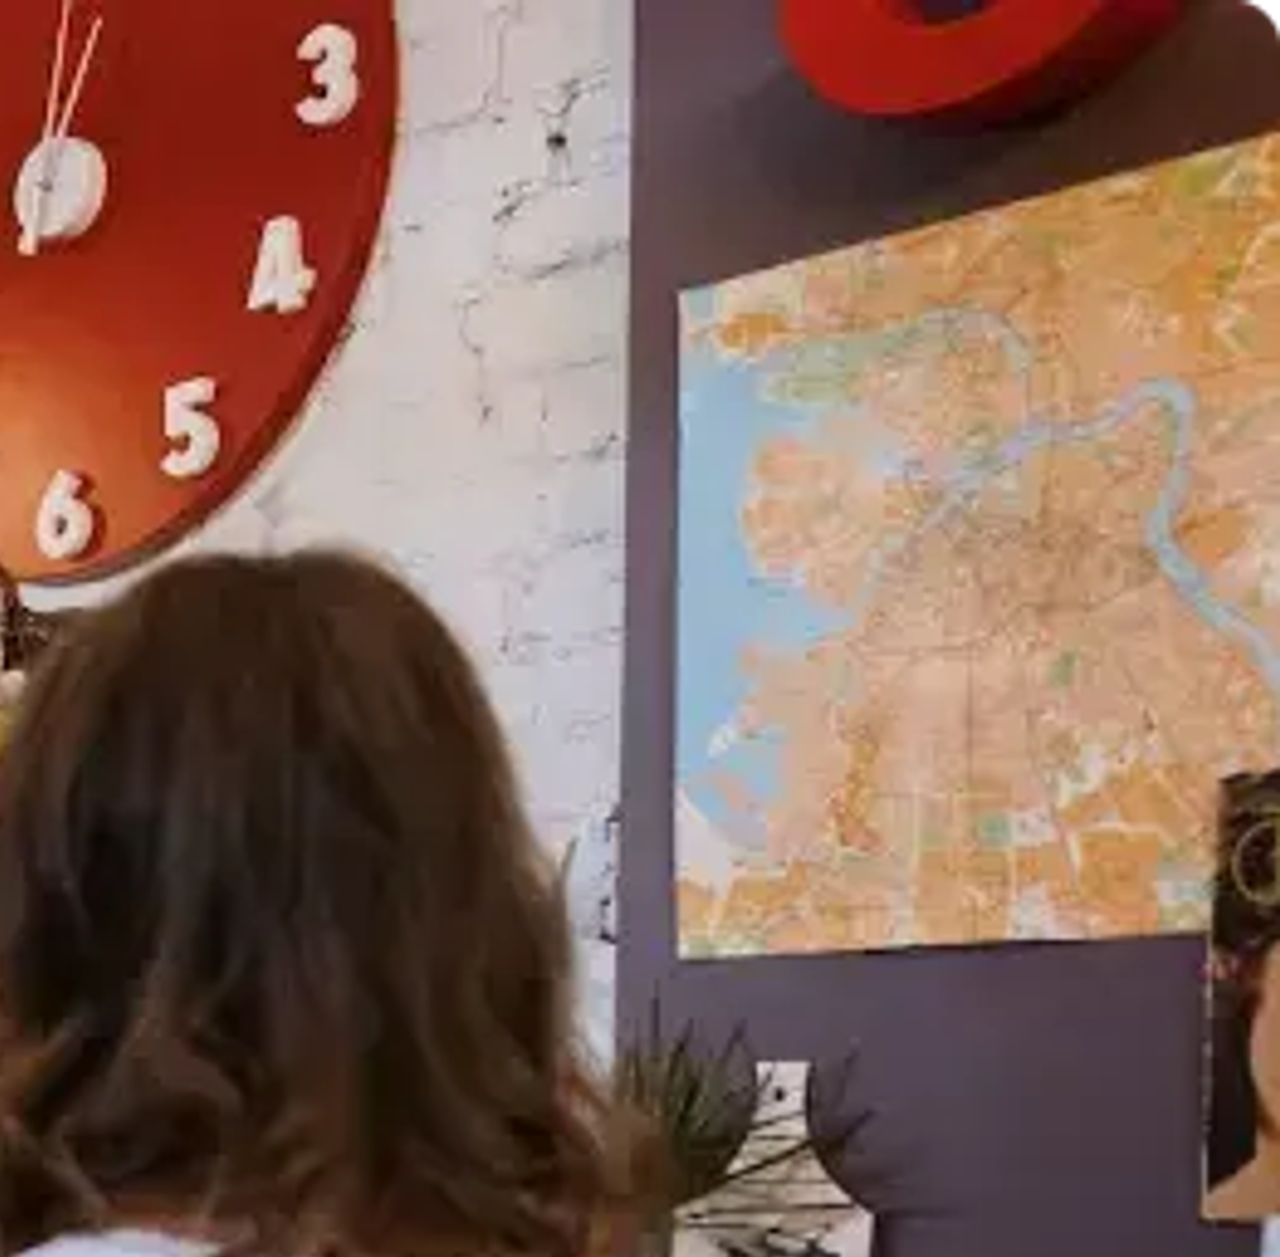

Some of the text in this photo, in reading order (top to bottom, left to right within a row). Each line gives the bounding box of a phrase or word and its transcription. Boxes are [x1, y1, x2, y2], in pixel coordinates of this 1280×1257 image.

[296, 23, 359, 126] 3
[247, 215, 316, 313] 4
[160, 377, 220, 478] 5
[36, 468, 96, 558] 6
